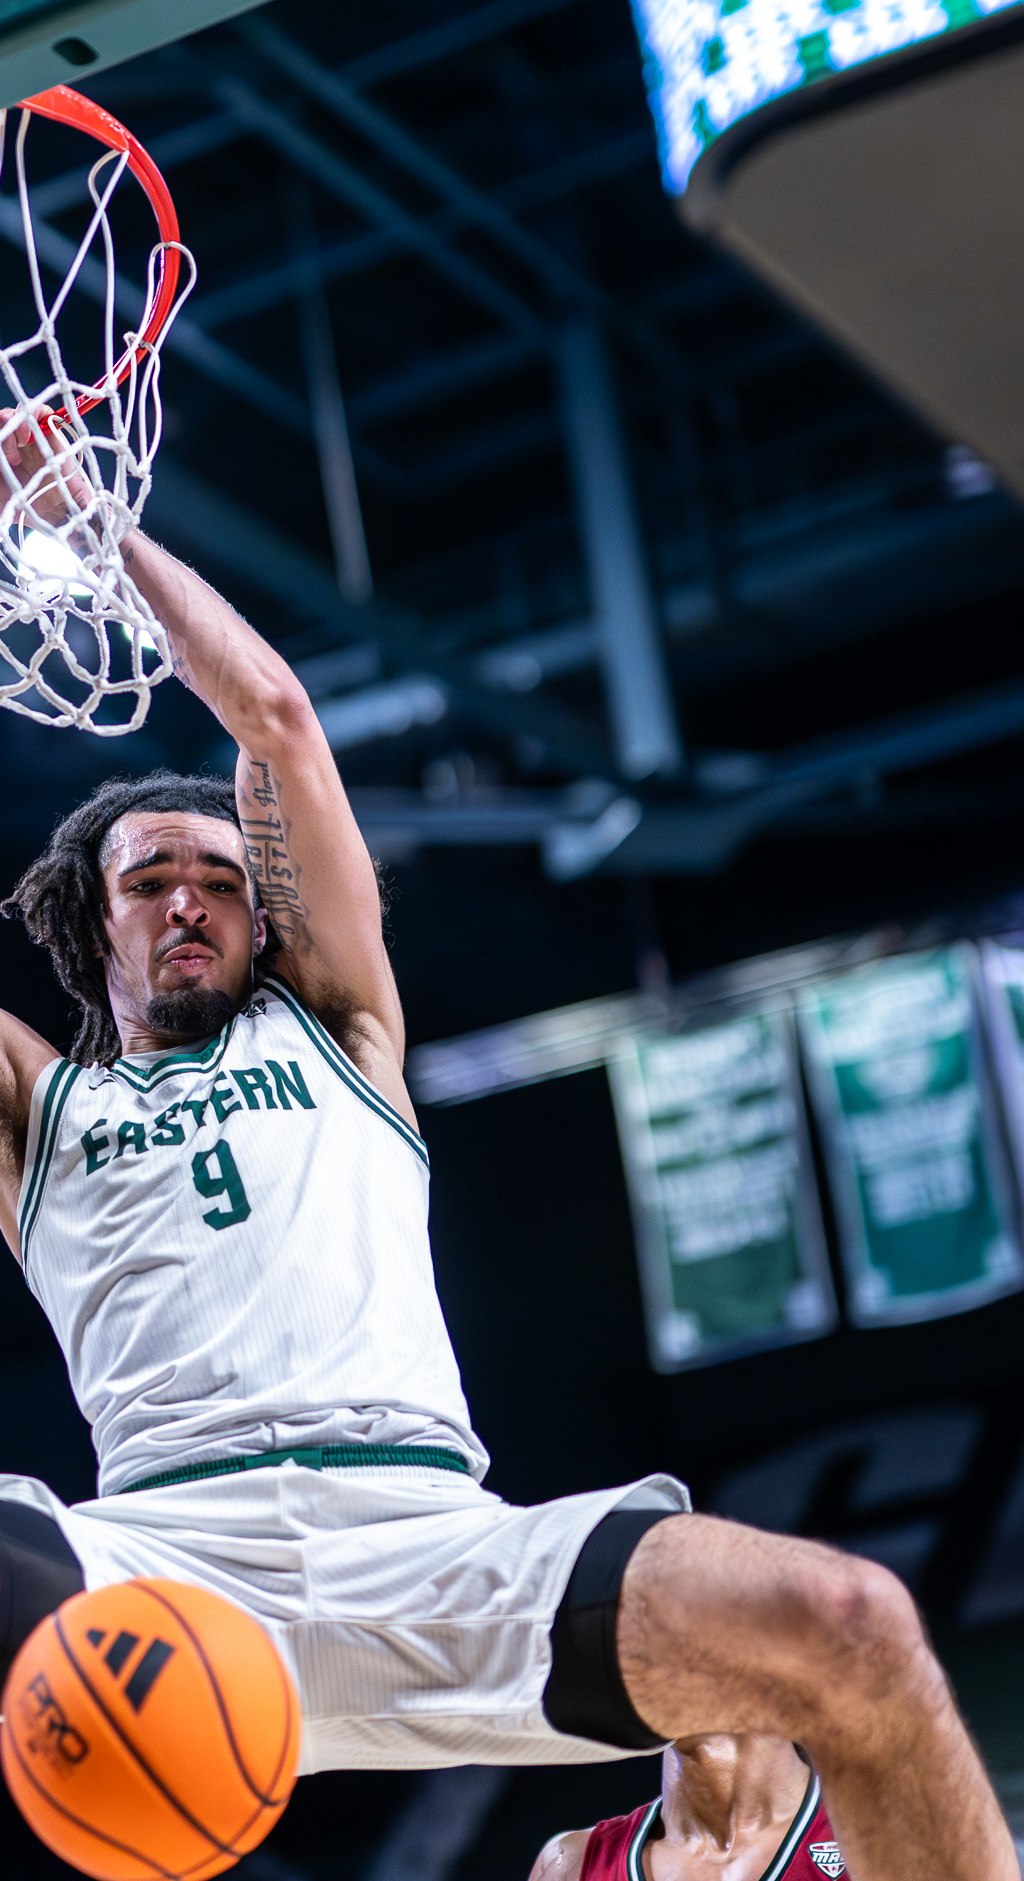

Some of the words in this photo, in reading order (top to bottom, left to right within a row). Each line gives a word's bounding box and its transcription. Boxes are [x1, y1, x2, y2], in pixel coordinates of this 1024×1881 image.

[81, 1059, 318, 1176] EASTERN
[192, 1139, 252, 1232] 9
[26, 1671, 91, 1766] PRO
